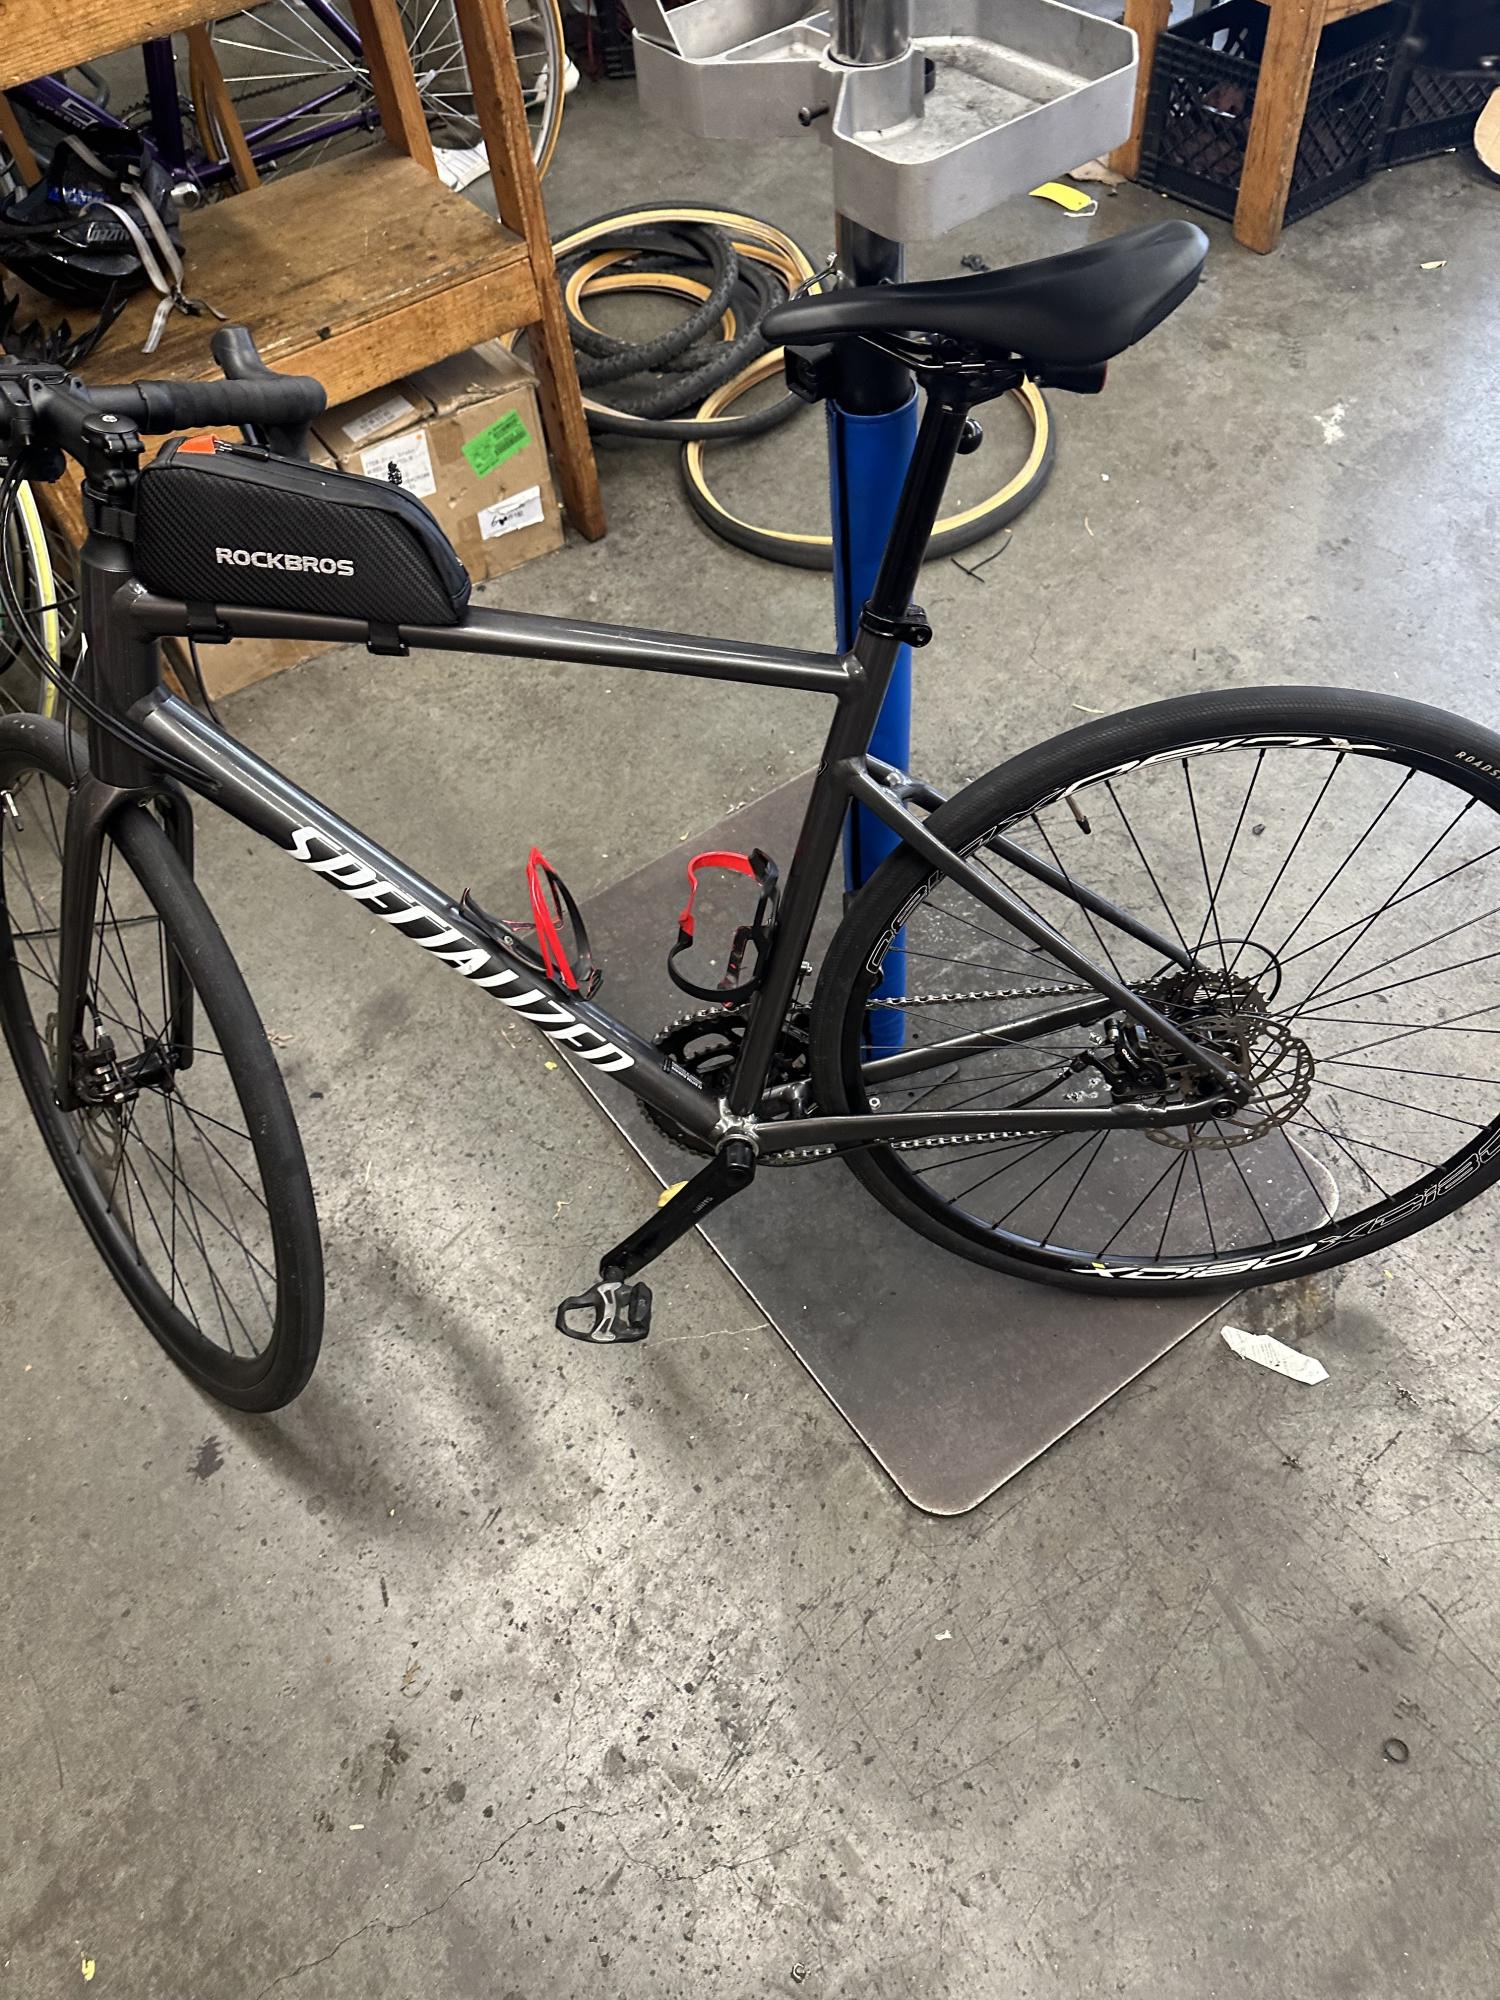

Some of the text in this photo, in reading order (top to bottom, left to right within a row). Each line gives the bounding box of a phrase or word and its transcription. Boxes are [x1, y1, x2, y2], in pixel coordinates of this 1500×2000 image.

[215, 547, 355, 577] ROCKBROS
[1455, 751, 1500, 779] ROADS
[286, 825, 635, 1073] SPECIALIZED
